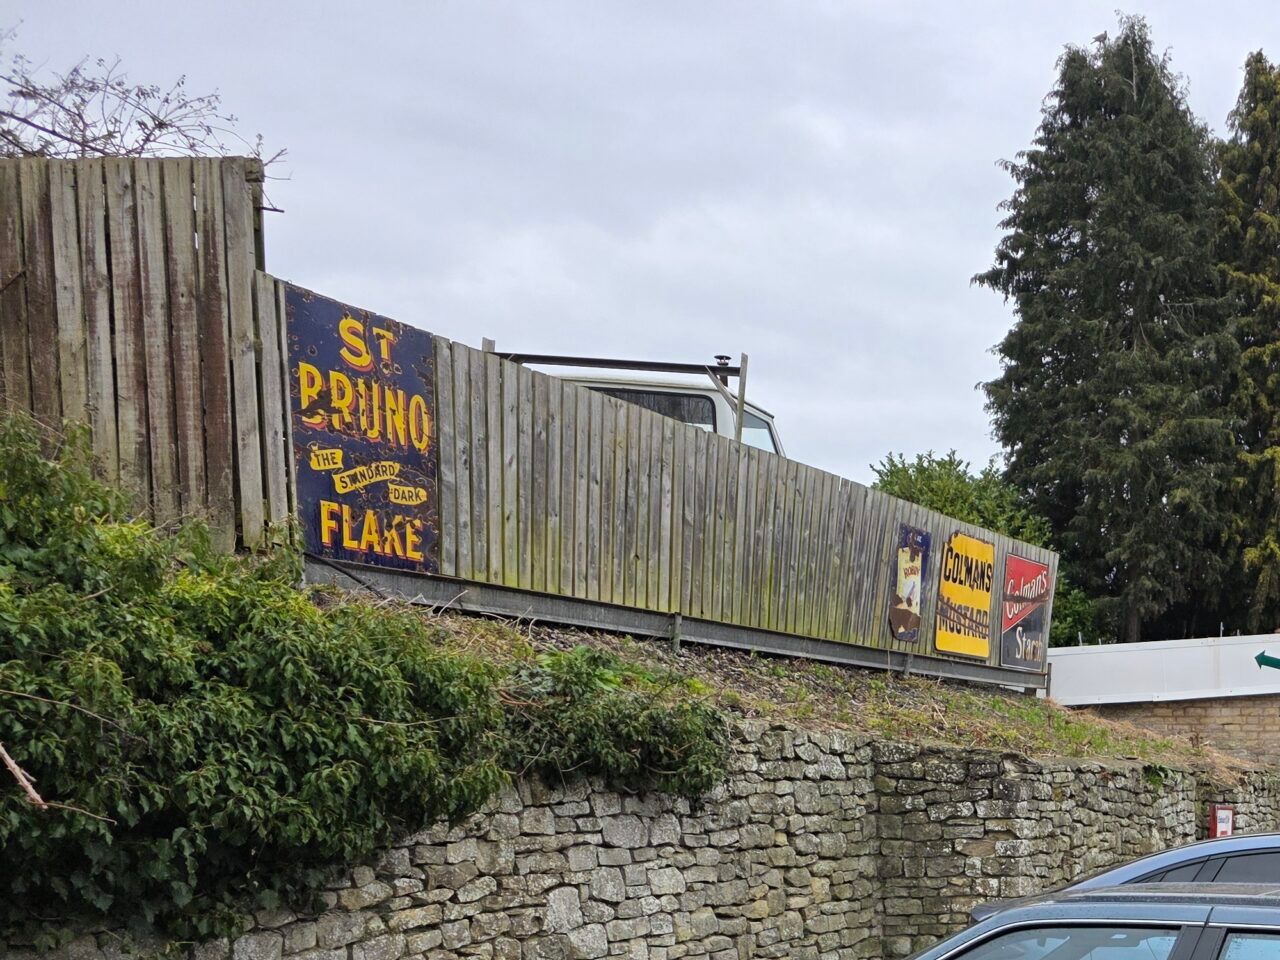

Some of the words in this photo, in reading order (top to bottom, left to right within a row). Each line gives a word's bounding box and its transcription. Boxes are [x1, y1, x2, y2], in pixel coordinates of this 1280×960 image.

[338, 316, 395, 372] ST
[297, 362, 432, 454] BRUNO
[315, 451, 339, 467] THE
[339, 463, 395, 489] STANDARD
[393, 488, 423, 502] DARK
[319, 500, 425, 562] FLAKE
[943, 546, 992, 593] COLMAN'S
